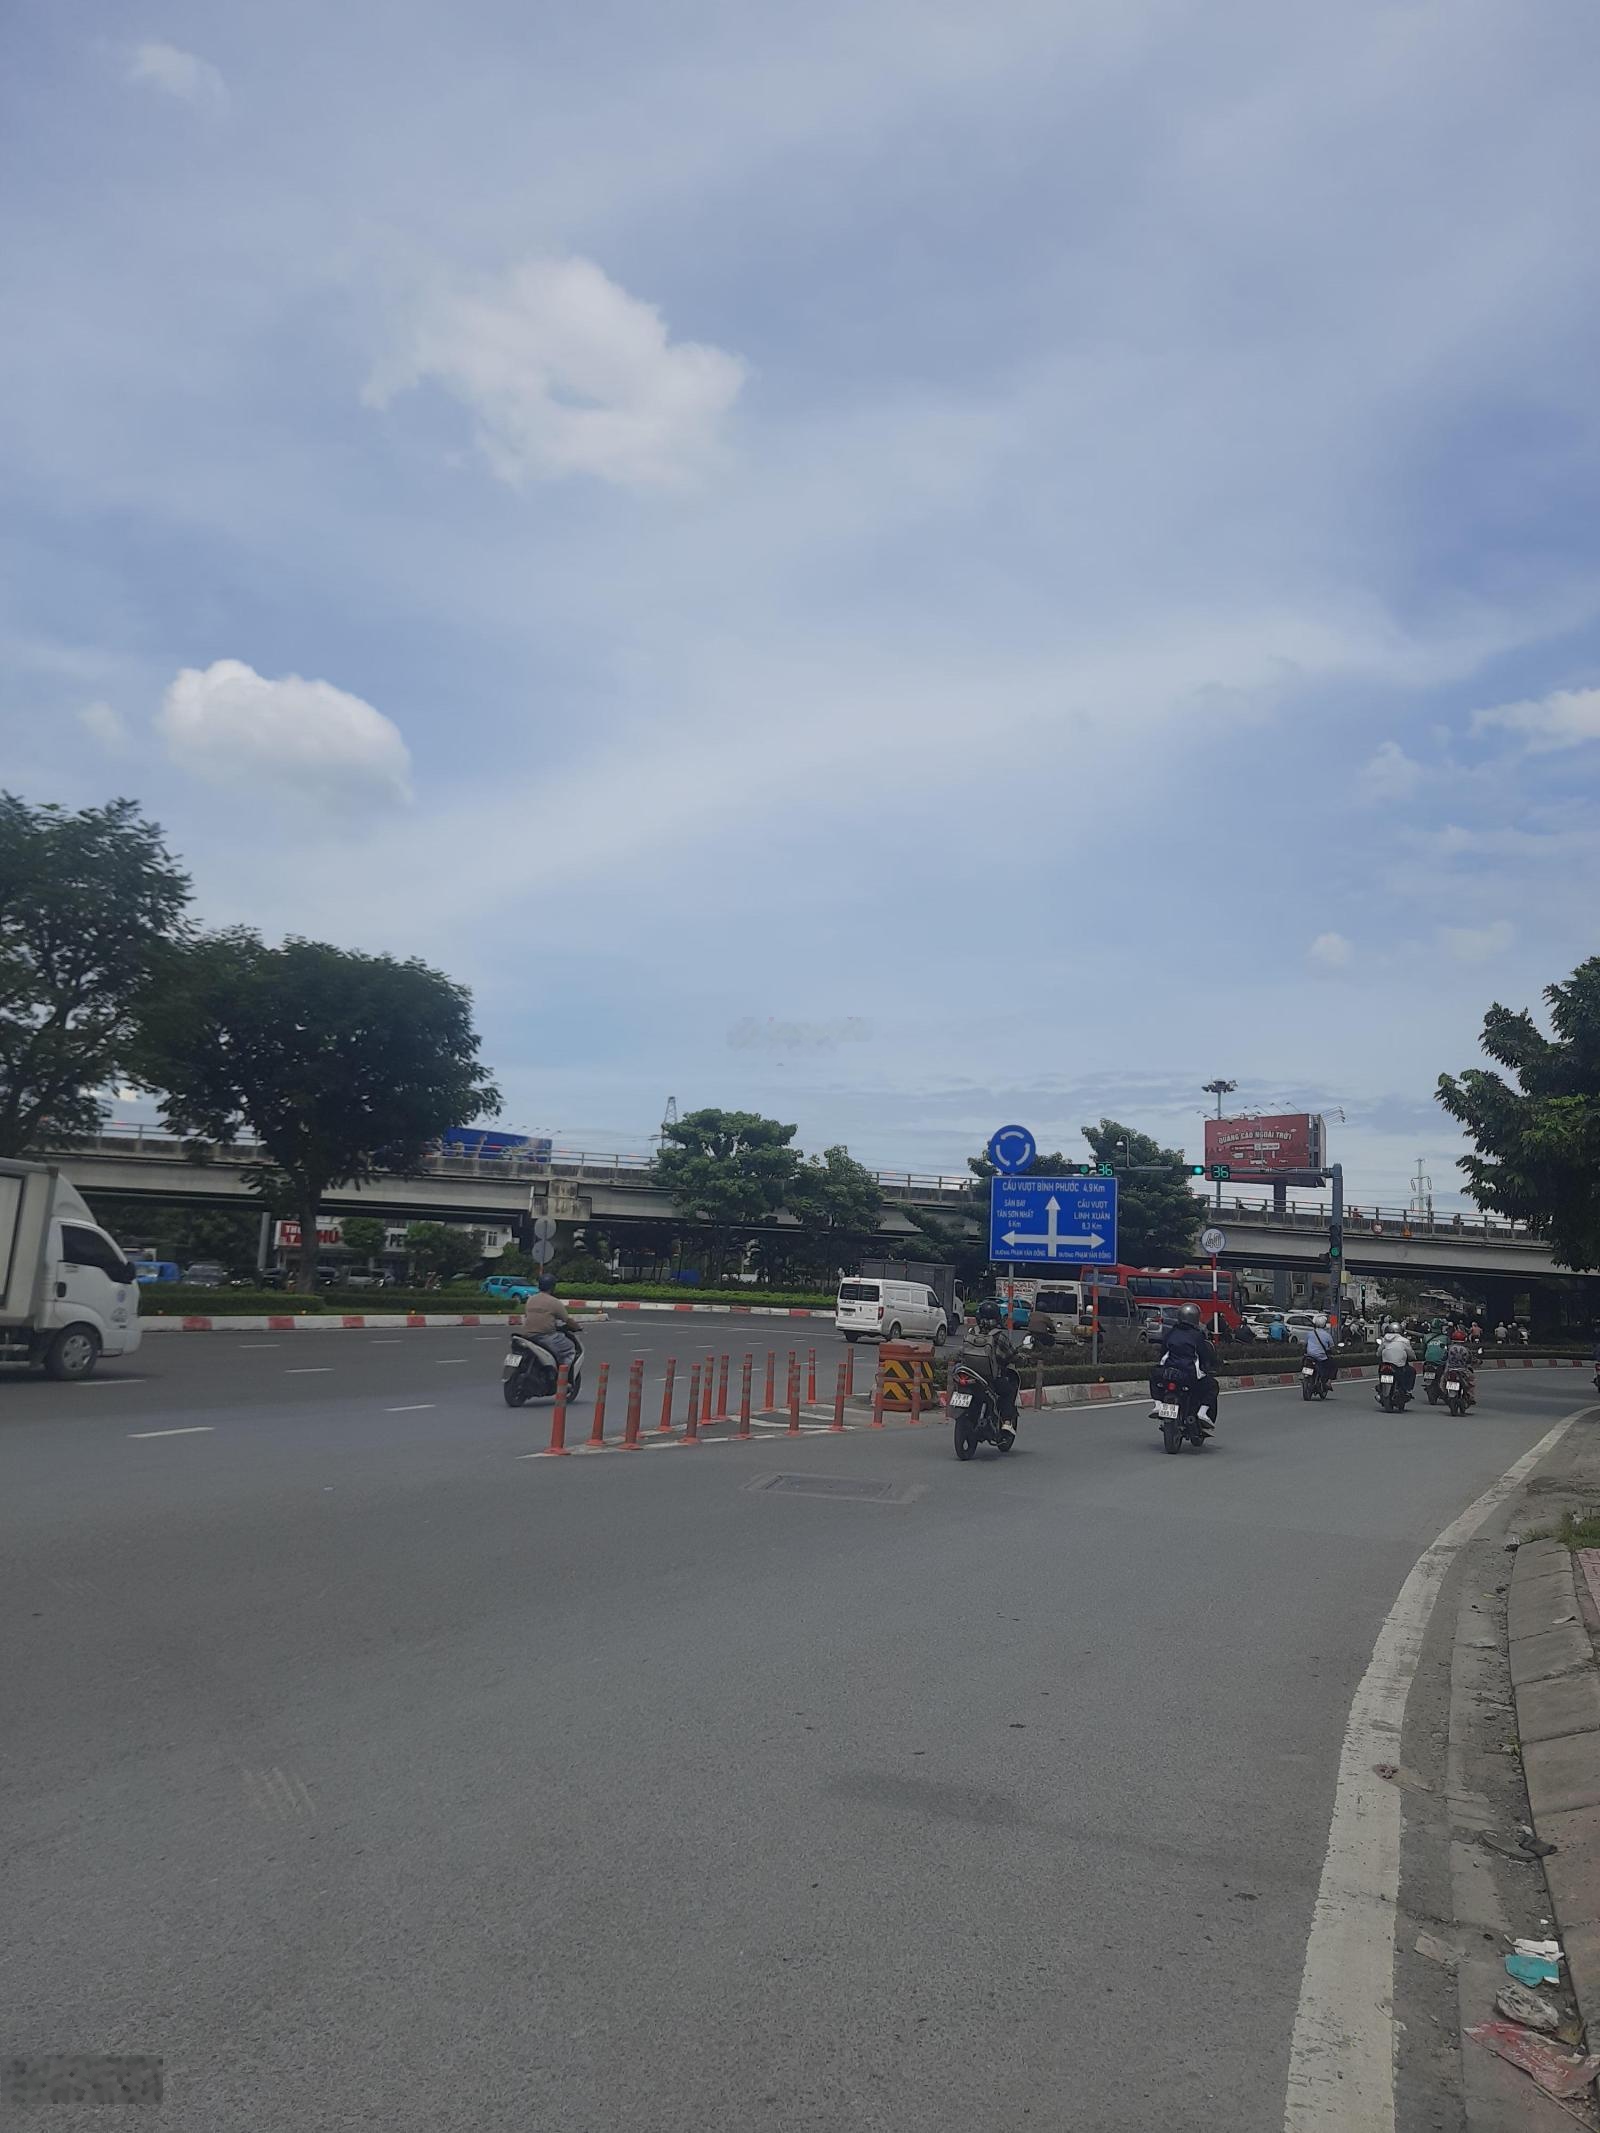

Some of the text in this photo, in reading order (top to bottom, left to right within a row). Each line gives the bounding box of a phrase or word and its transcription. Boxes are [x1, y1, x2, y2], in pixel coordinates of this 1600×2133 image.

[1098, 1163, 1113, 1176] 36
[1213, 1165, 1229, 1178] 36
[1002, 1180, 1017, 1191] CẦU
[1018, 1182, 1036, 1192] VƯỢT
[1037, 1181, 1054, 1192] BÌNH
[1055, 1181, 1080, 1192] PHƯỚC
[1077, 1198, 1108, 1209] CẦU VƯỢT
[1073, 1211, 1110, 1220] LINH XUÂN
[1205, 1233, 1222, 1249] 40
